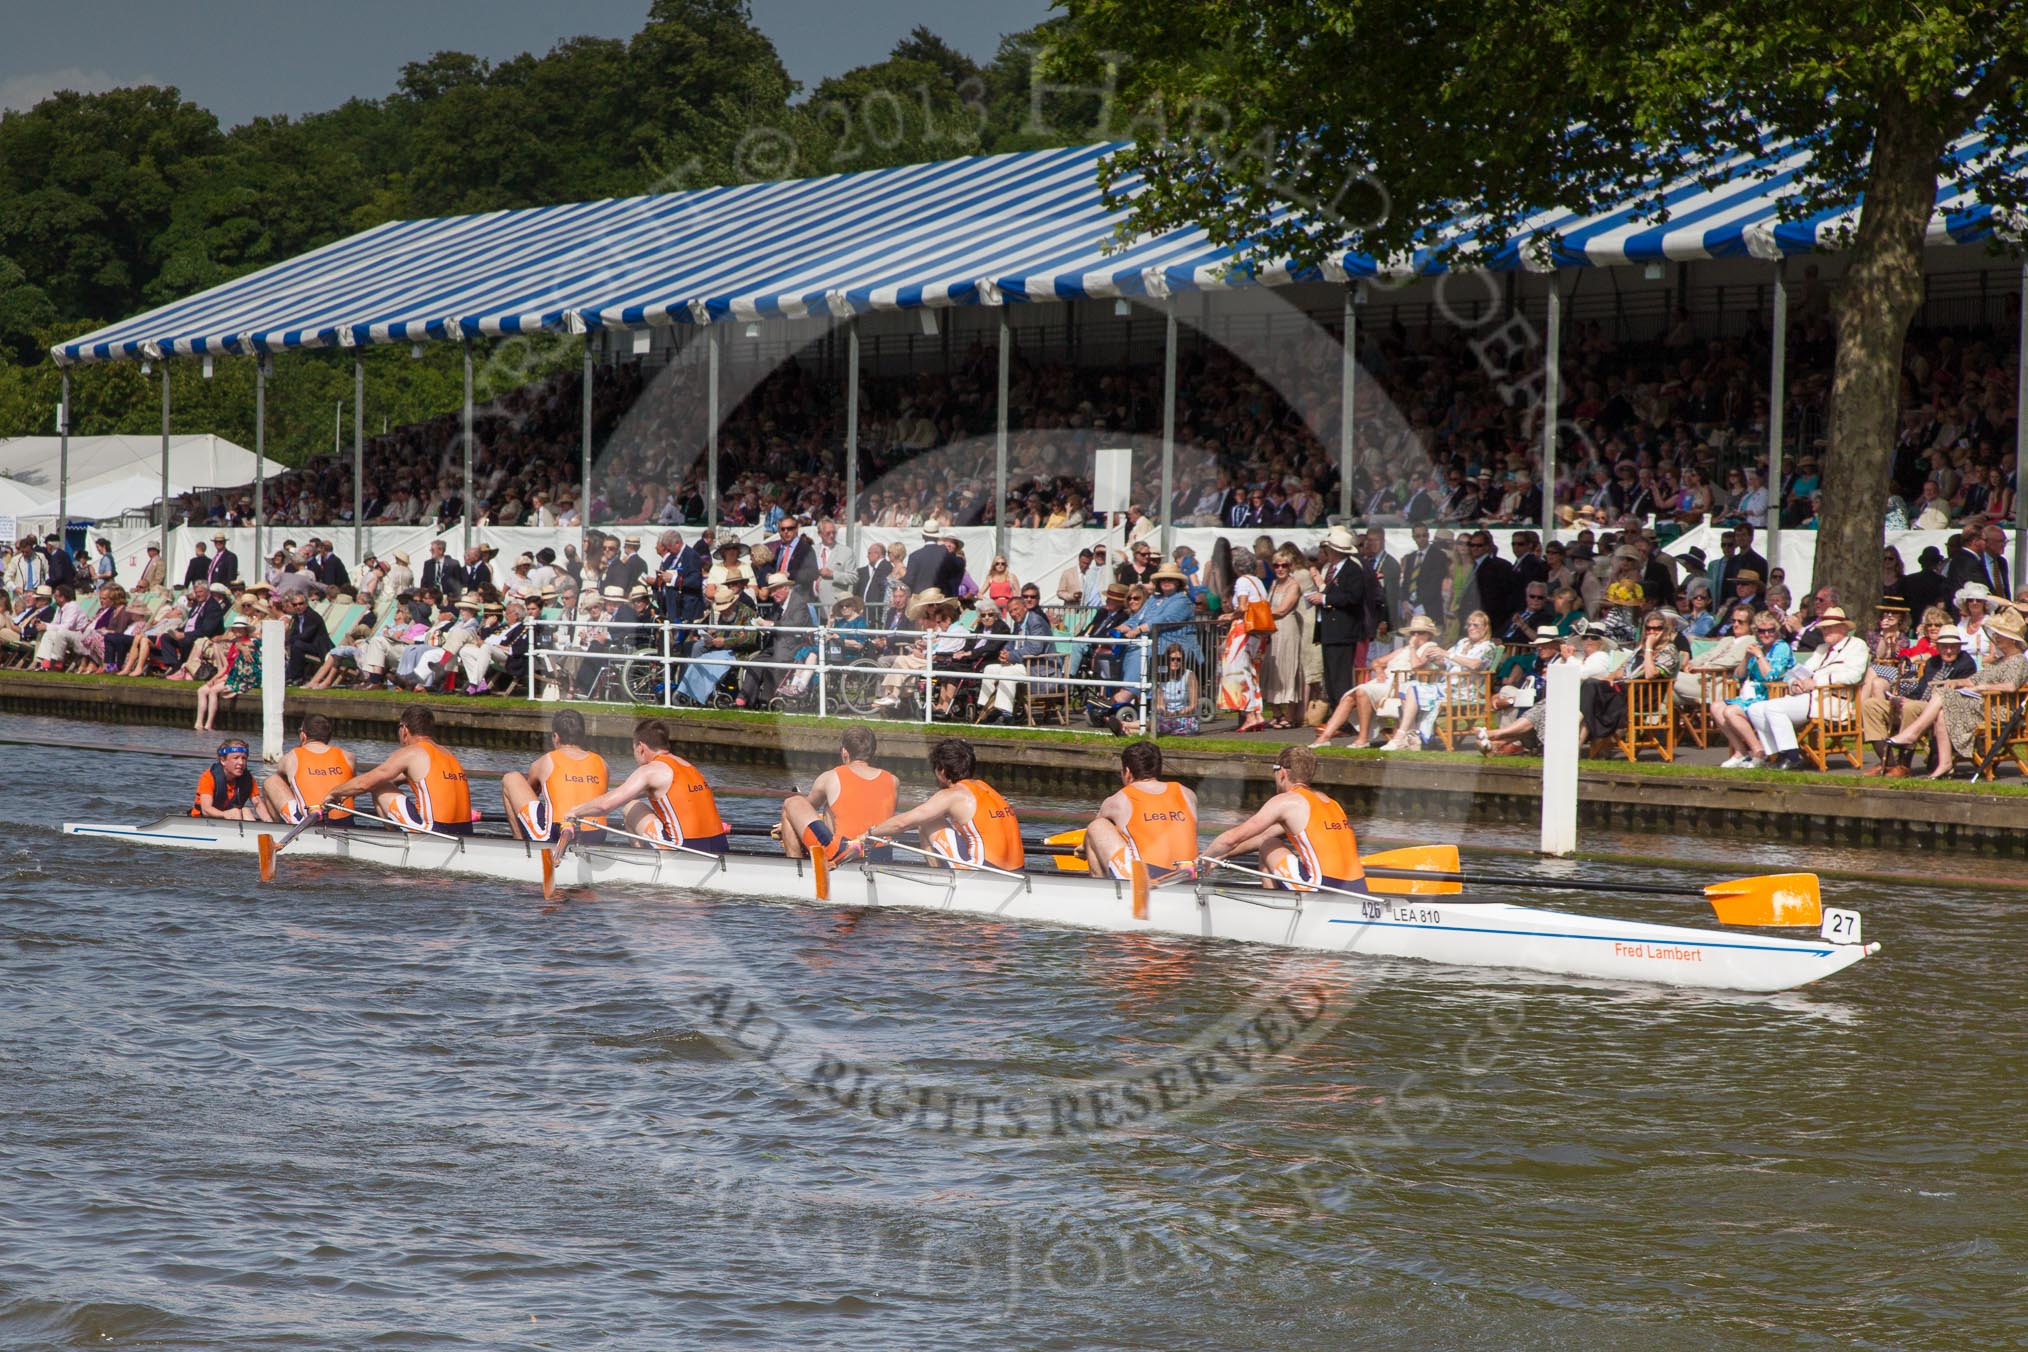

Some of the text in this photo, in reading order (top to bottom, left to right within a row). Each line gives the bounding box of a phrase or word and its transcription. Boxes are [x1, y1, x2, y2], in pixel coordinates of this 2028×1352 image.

[308, 766, 343, 776] Lea RC
[443, 771, 457, 781] Lea
[565, 773, 600, 784] Lea RC
[688, 783, 704, 793] Lea
[989, 808, 1005, 818] Lea
[1143, 810, 1186, 822] Lea RC
[1324, 820, 1341, 830] Lea
[1361, 901, 1381, 919] 426
[1393, 908, 1440, 923] LEA 810
[1832, 913, 1855, 936] 27
[1615, 942, 1702, 962] Fred Lambert
